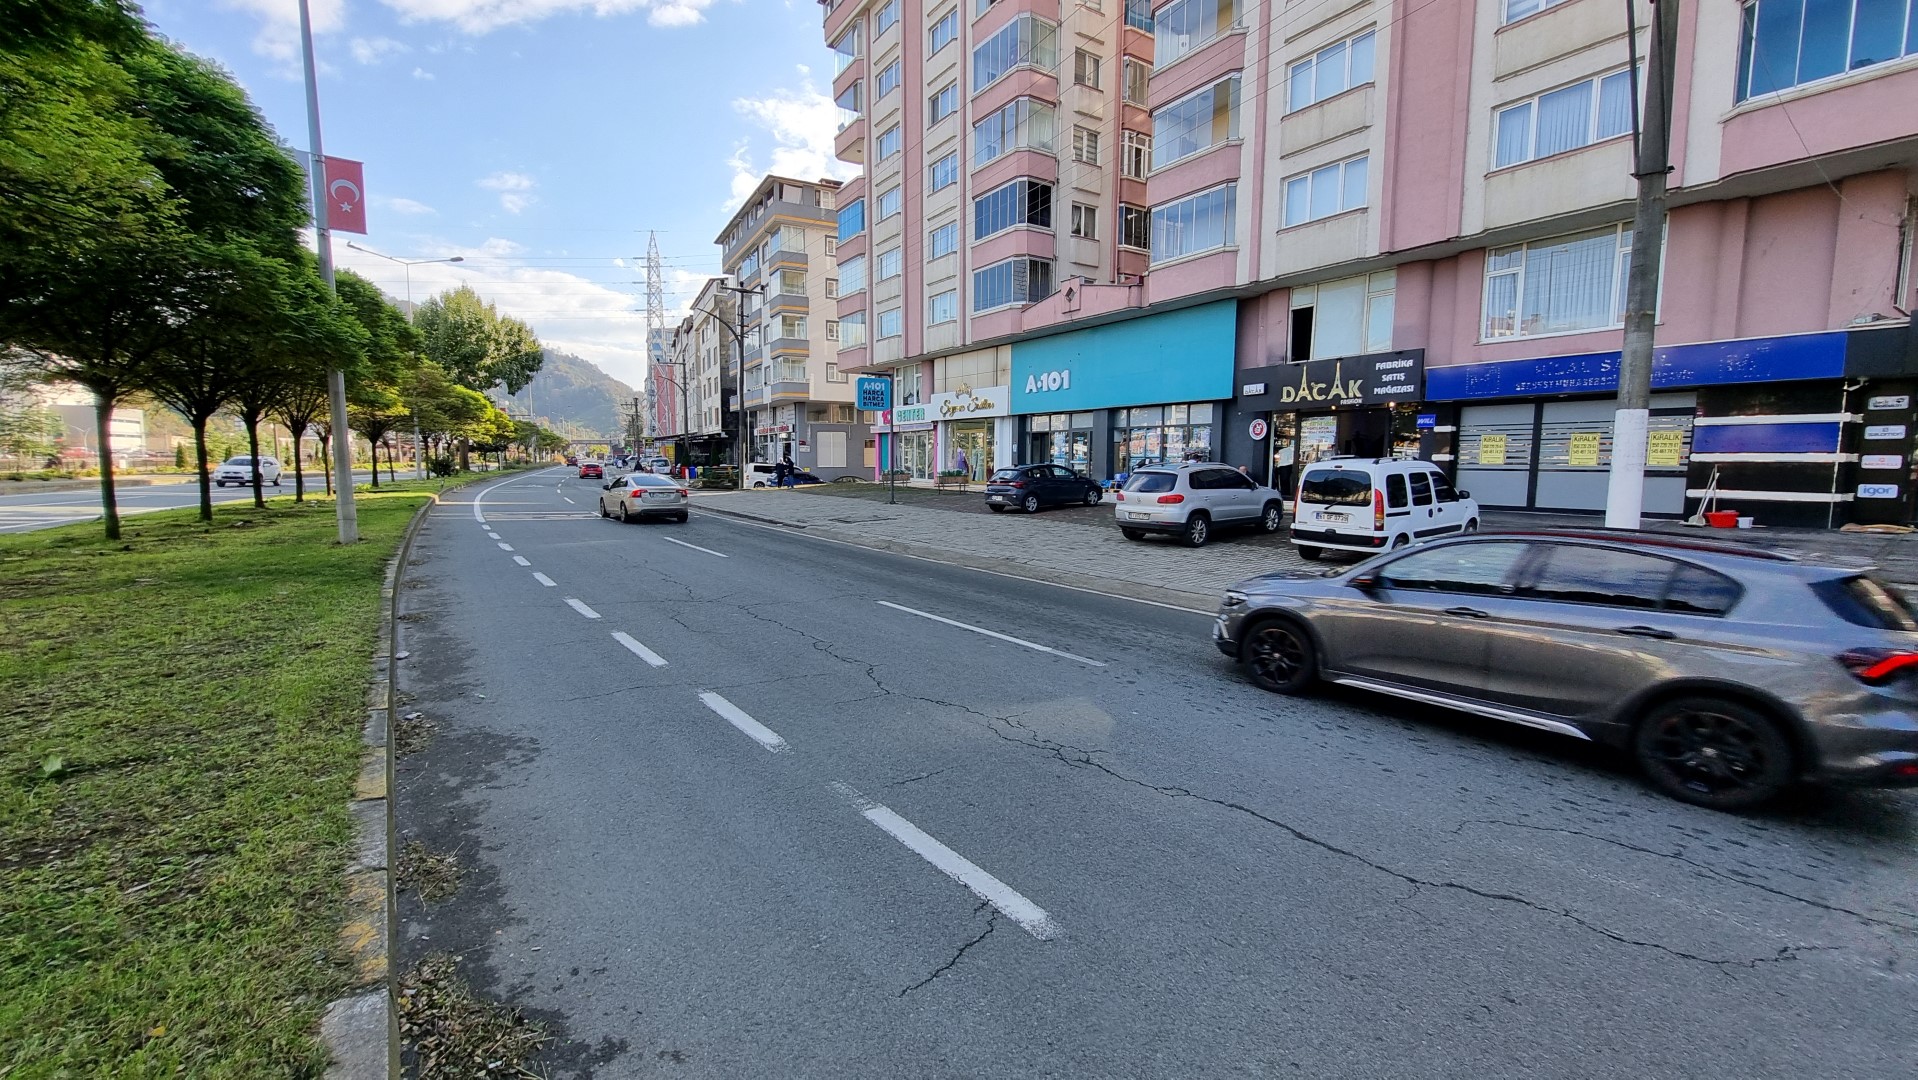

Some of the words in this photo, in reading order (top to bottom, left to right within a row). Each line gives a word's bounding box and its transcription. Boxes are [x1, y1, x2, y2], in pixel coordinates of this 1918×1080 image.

[1375, 359, 1414, 371] FABRİKA
[1381, 372, 1406, 382] SATIŞ
[1373, 384, 1415, 395] MAĞAZASI
[1863, 485, 1892, 496] igor
